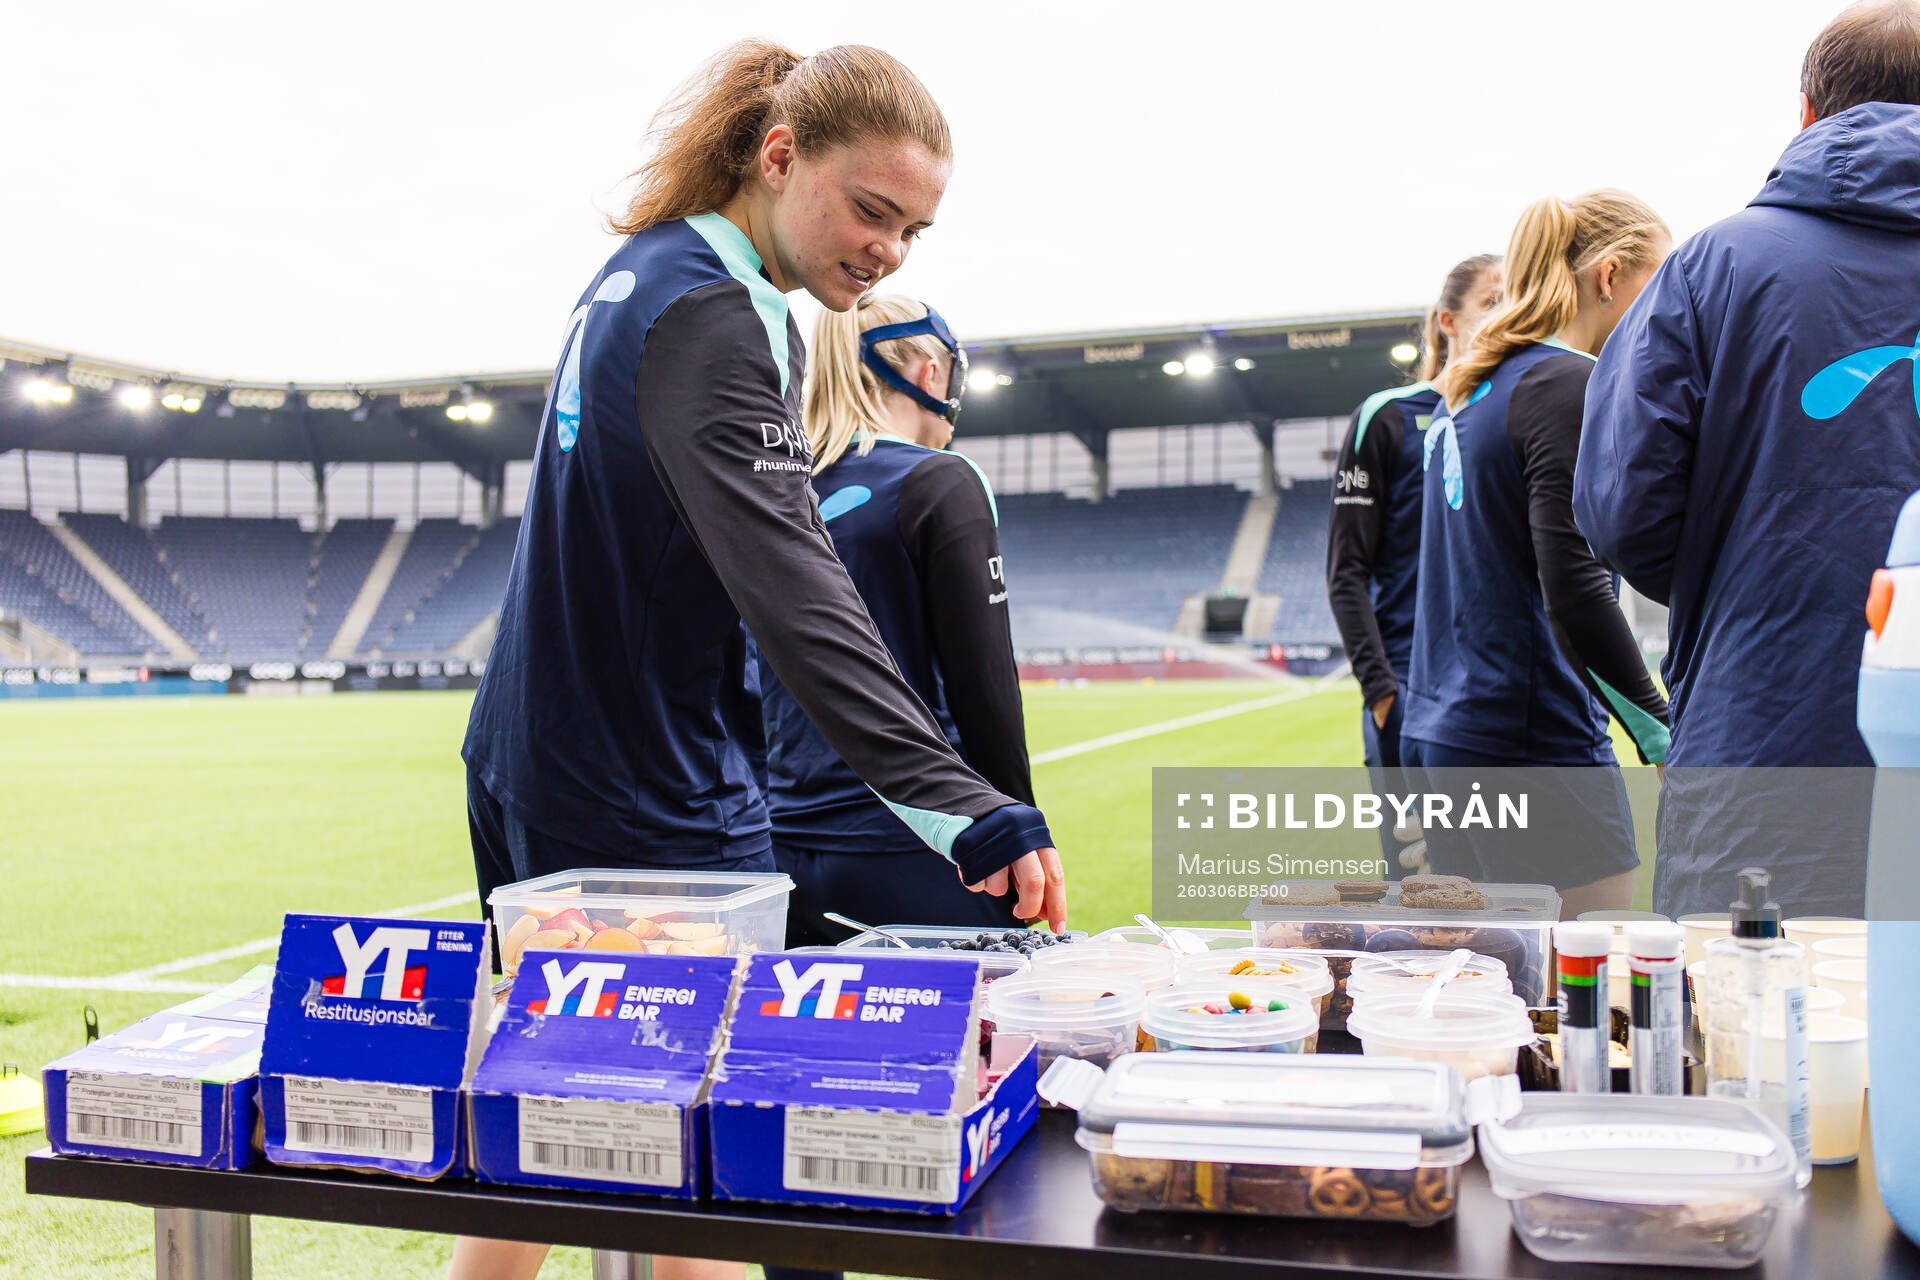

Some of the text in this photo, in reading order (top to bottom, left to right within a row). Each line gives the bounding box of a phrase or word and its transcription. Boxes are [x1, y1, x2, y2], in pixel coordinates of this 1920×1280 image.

[437, 930, 465, 941] ETTER
[436, 941, 473, 953] TRENING
[332, 921, 431, 1002] YT
[541, 958, 626, 1017] YT
[623, 985, 697, 1006] ENERGI
[772, 959, 864, 1019] YT
[864, 986, 942, 1007] ENERGI
[304, 1001, 436, 1026] Restitusjonsbar
[618, 1003, 661, 1021] BAR
[859, 1005, 905, 1023] BAR
[288, 1079, 323, 1090] TINE SA
